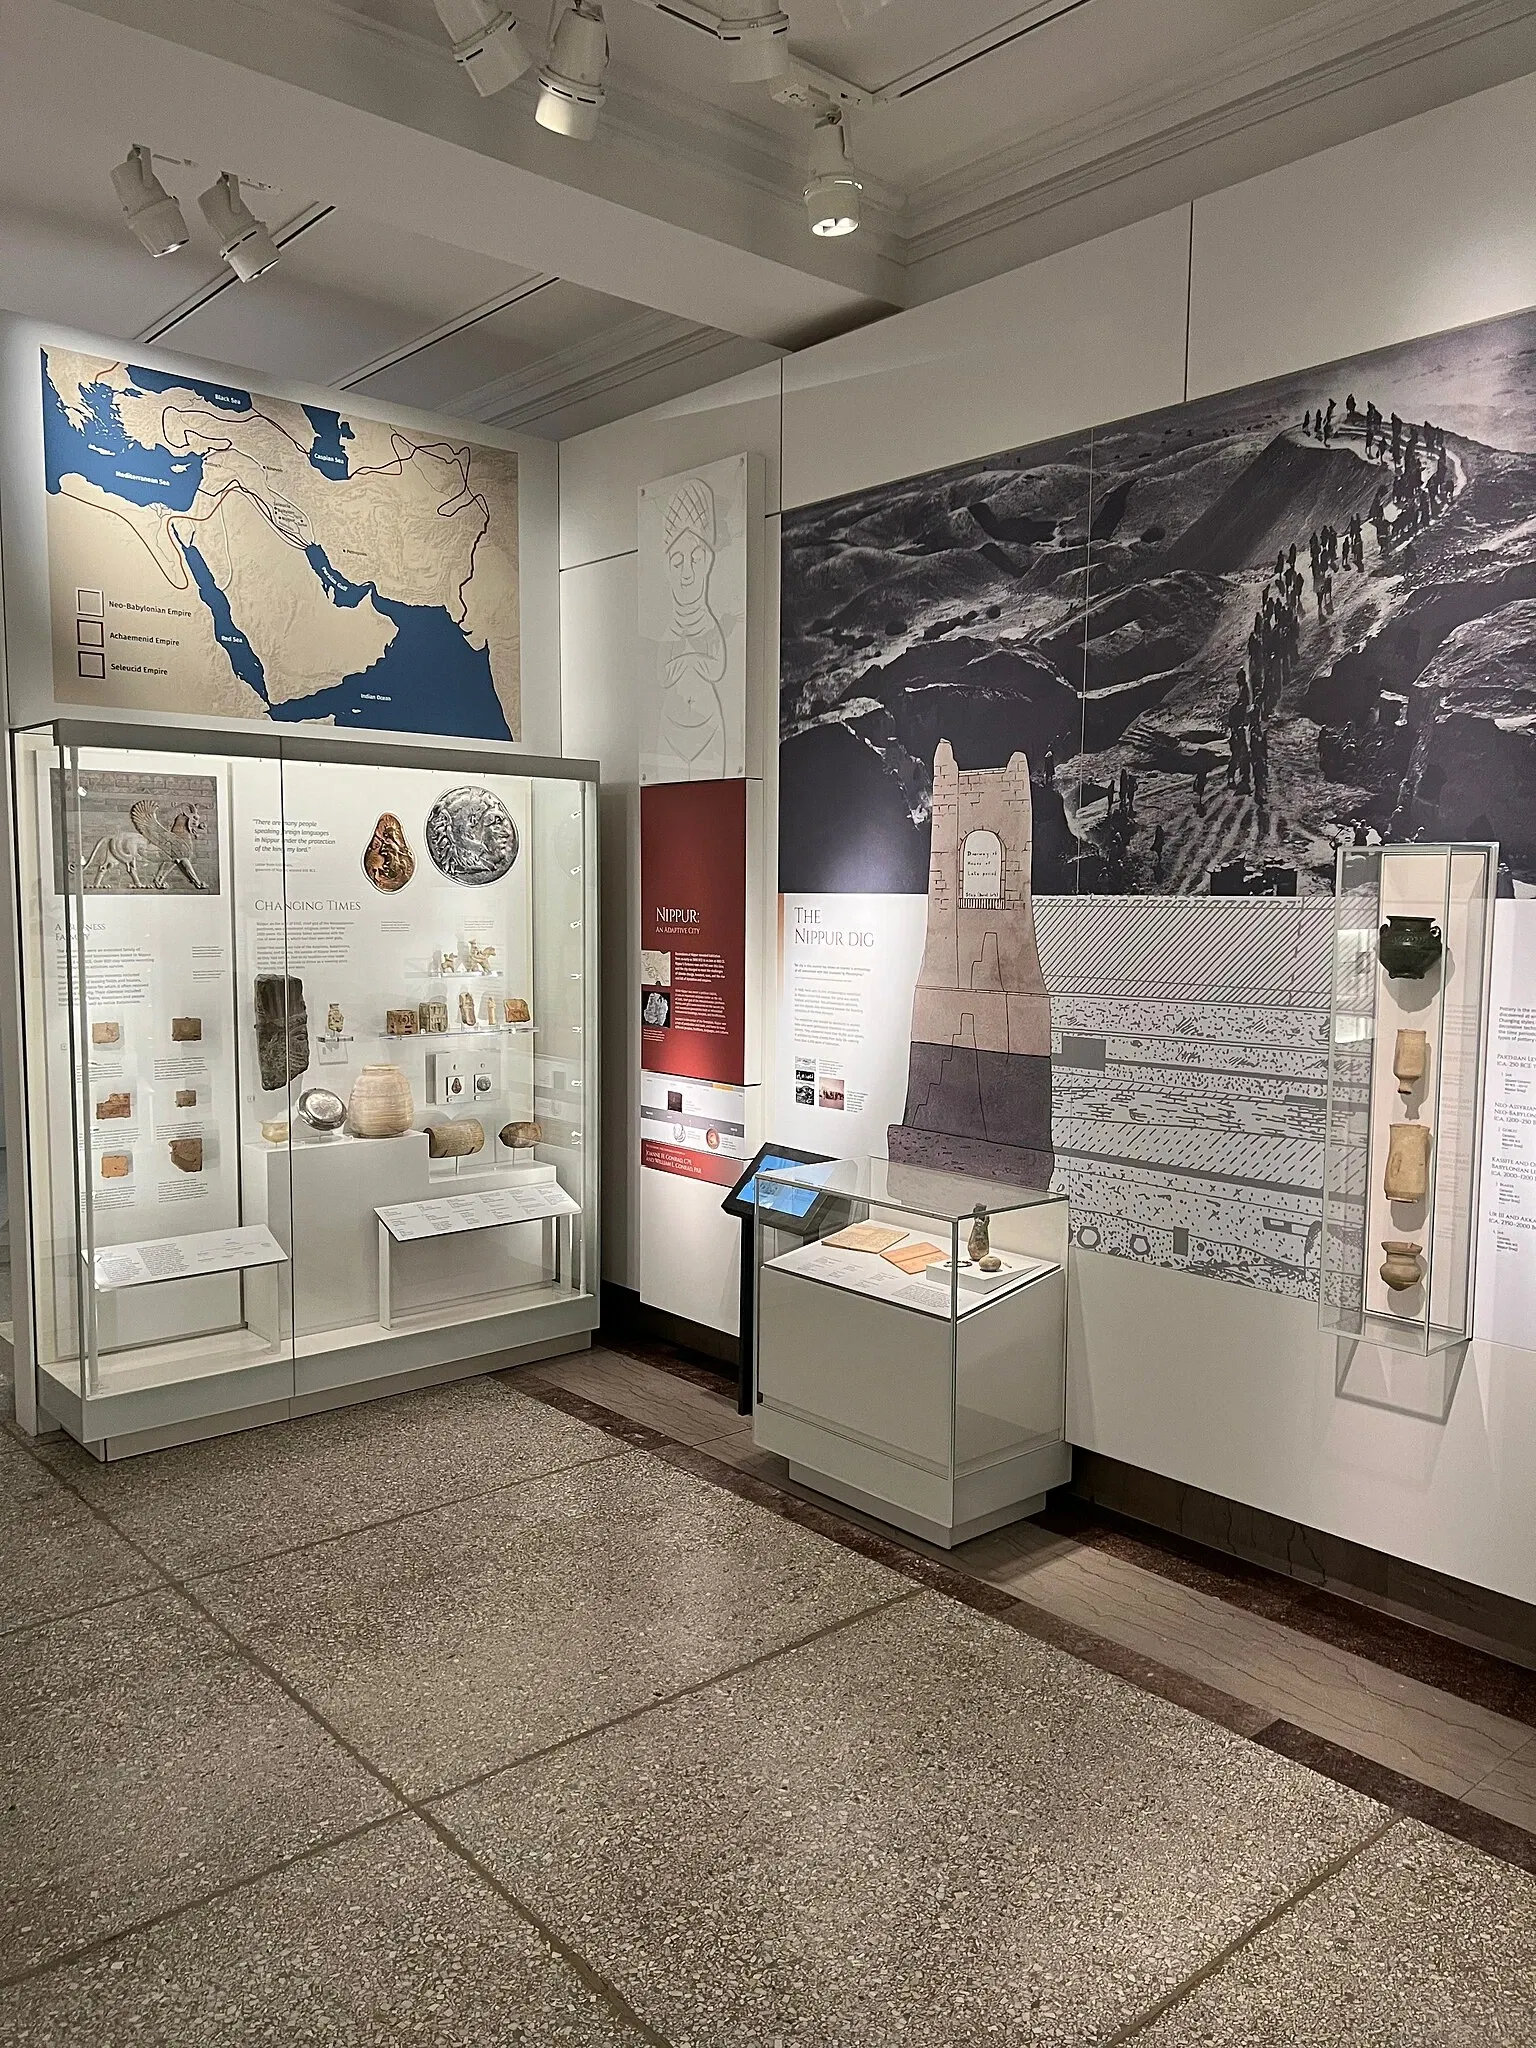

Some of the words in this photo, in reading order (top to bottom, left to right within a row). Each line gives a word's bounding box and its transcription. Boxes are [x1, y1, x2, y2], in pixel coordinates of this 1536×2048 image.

[214, 394, 230, 402] Black
[230, 397, 241, 405] Sea
[314, 453, 334, 462] Caspian
[116, 470, 158, 484] Mediterranean
[322, 566, 337, 584] Persian
[336, 581, 348, 592] Gulf
[108, 601, 166, 614] Neo-Babylonian
[167, 608, 192, 618] Empire
[110, 632, 154, 643] Achaemenid
[156, 636, 180, 646] Empire
[111, 663, 142, 673] Seleucid
[144, 667, 168, 676] Empire
[255, 900, 323, 911] CHANGING
[326, 900, 361, 910] TIMES
[656, 907, 700, 923] NIPPUR:
[794, 907, 821, 923] THE
[795, 928, 844, 946] NIPPUR
[848, 932, 874, 947] DIG
[1492, 1163, 1529, 1173] BABYLONIAN
